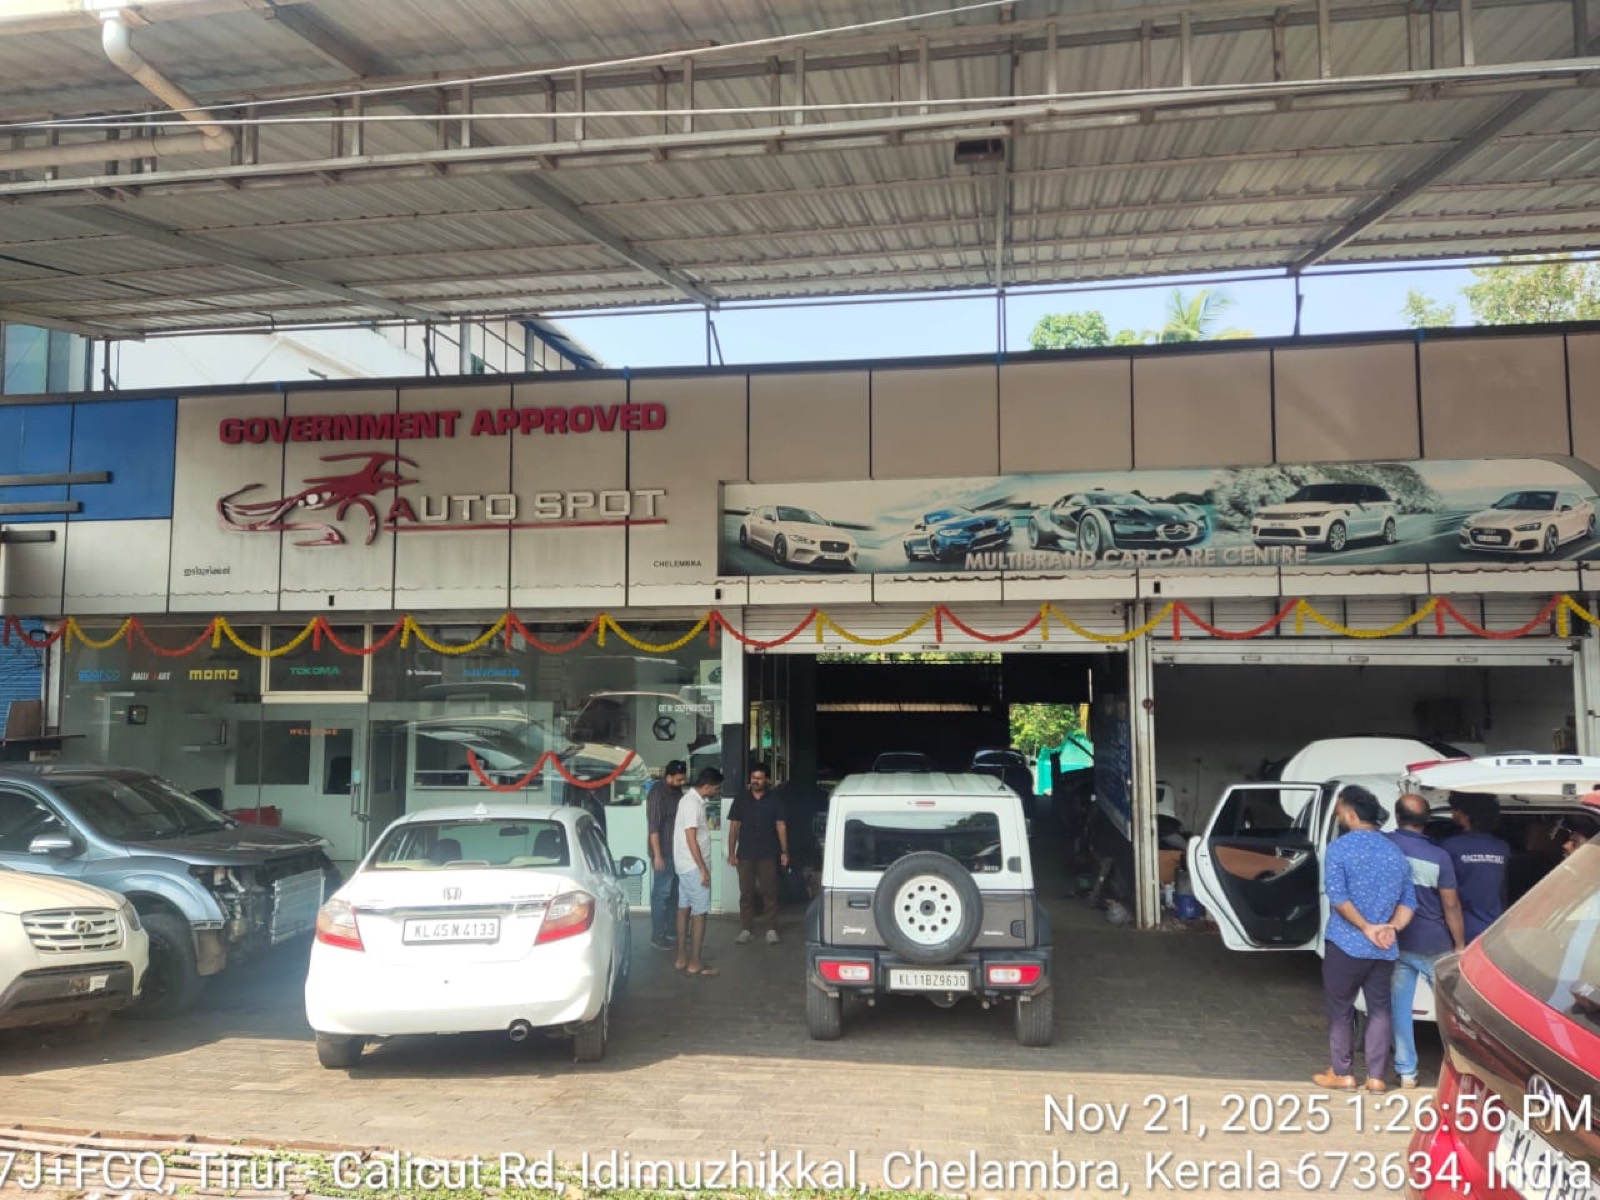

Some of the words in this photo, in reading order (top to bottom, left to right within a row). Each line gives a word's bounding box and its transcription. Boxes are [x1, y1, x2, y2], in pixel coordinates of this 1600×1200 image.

[219, 410, 461, 444] GOVERNMENT
[470, 402, 667, 436] APPROVED
[384, 492, 517, 523] AUTO
[534, 488, 667, 519] SPOT
[963, 551, 1097, 571] MULTIBRAND
[1103, 549, 1151, 568] CAR
[1155, 547, 1216, 567] CARE
[1222, 544, 1307, 566] CENTRE
